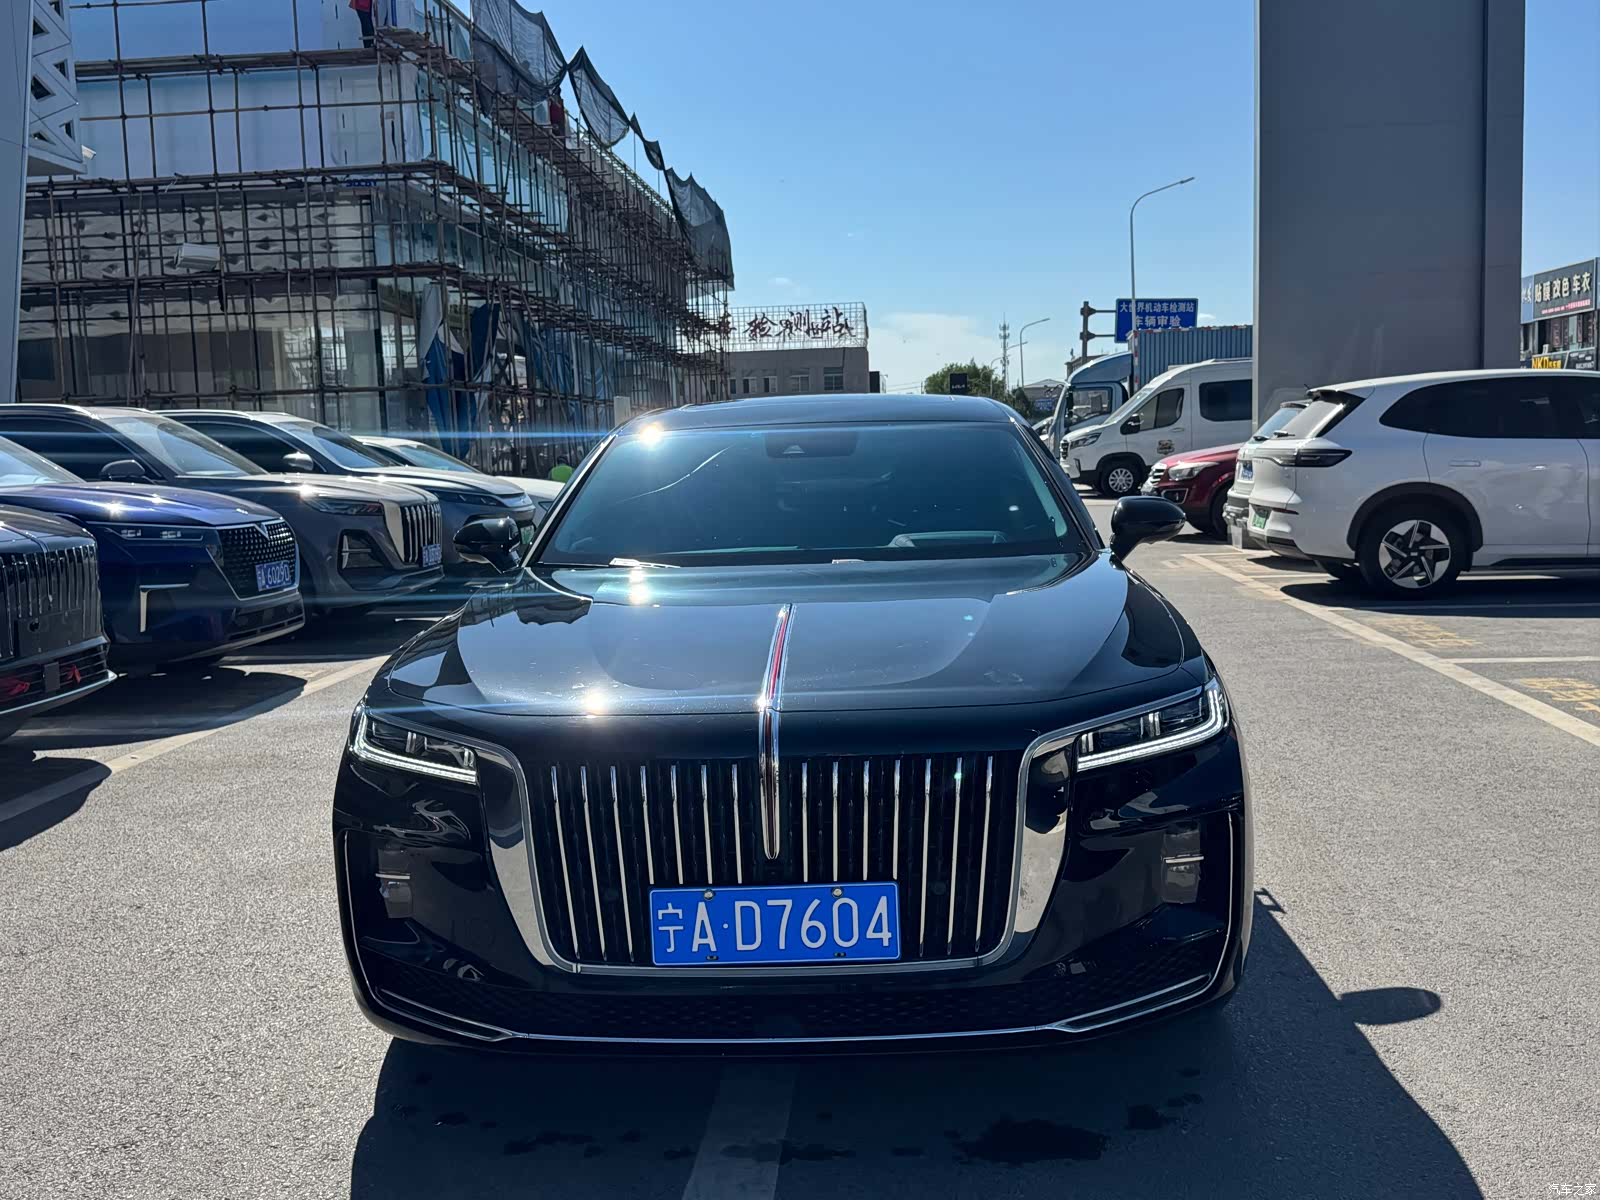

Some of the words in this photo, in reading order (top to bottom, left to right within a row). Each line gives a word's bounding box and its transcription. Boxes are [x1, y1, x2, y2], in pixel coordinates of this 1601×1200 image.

[1534, 272, 1591, 304] 贴膜改色车衣
[1135, 315, 1181, 327] 车辆审验
